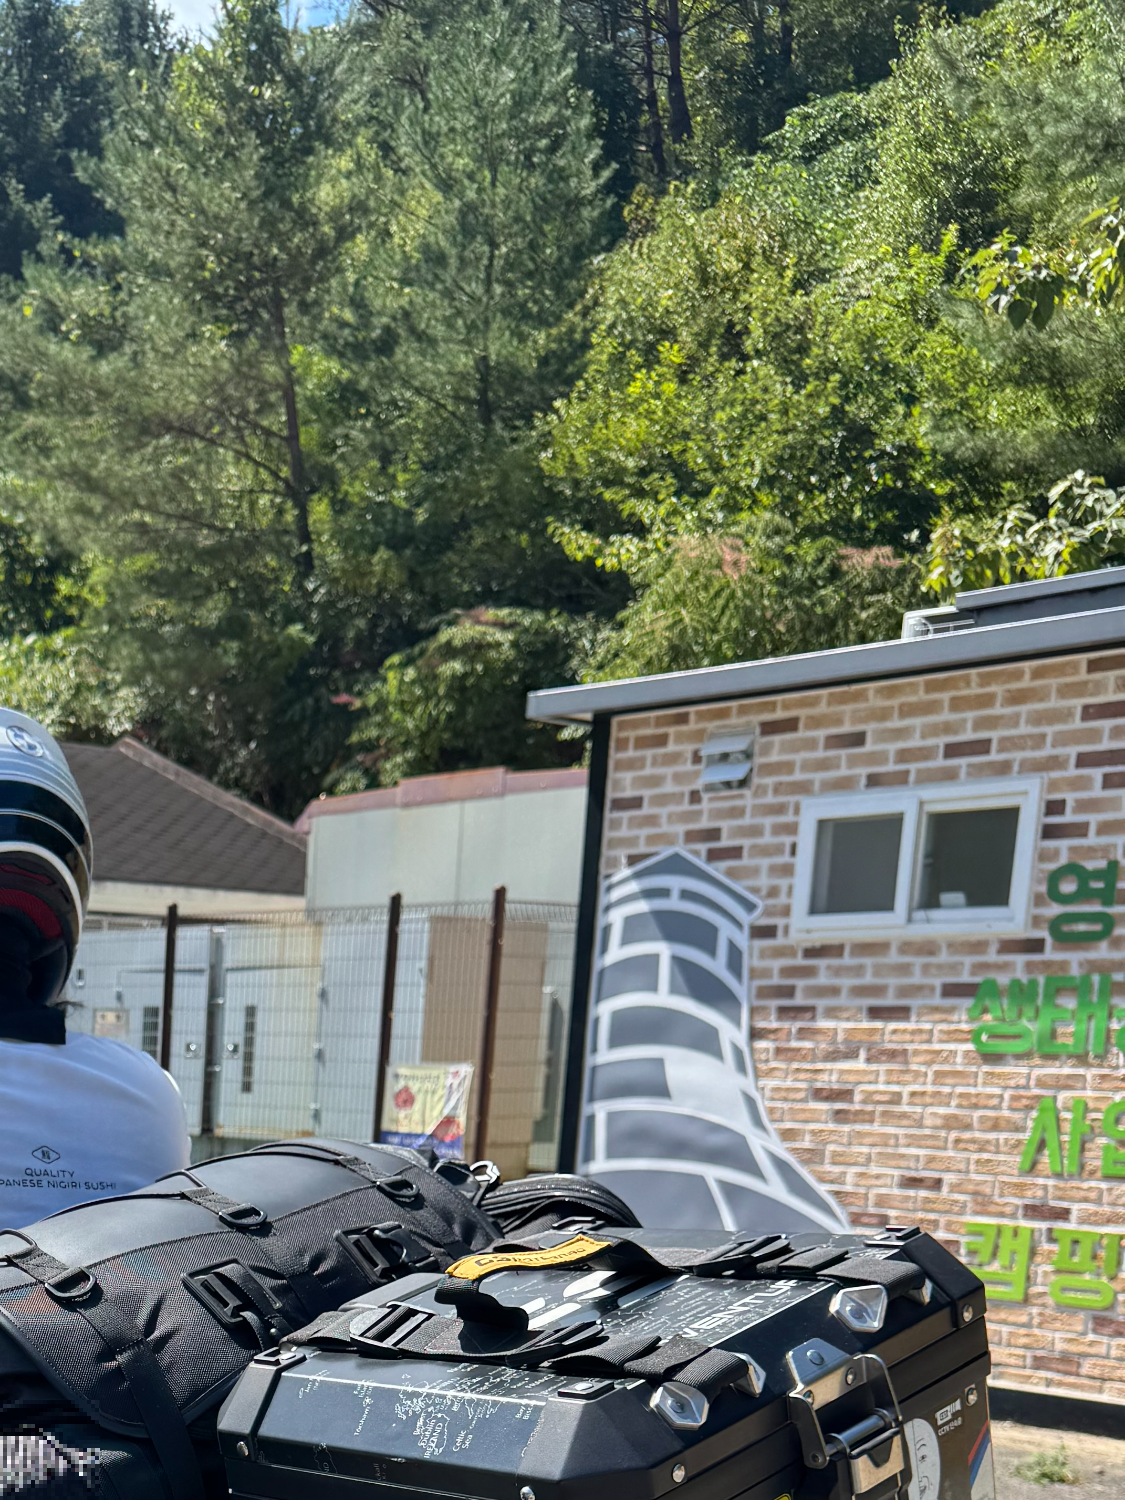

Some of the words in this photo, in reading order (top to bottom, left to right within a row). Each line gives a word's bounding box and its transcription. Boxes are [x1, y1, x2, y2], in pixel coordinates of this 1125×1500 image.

[968, 973, 1125, 1056] 생태
[24, 1167, 75, 1178] QUALITY
[47, 1180, 81, 1189] NIGIRI
[85, 1181, 117, 1190] SUSHI
[452, 1429, 467, 1453] Celtic
[461, 1433, 473, 1449] Sea
